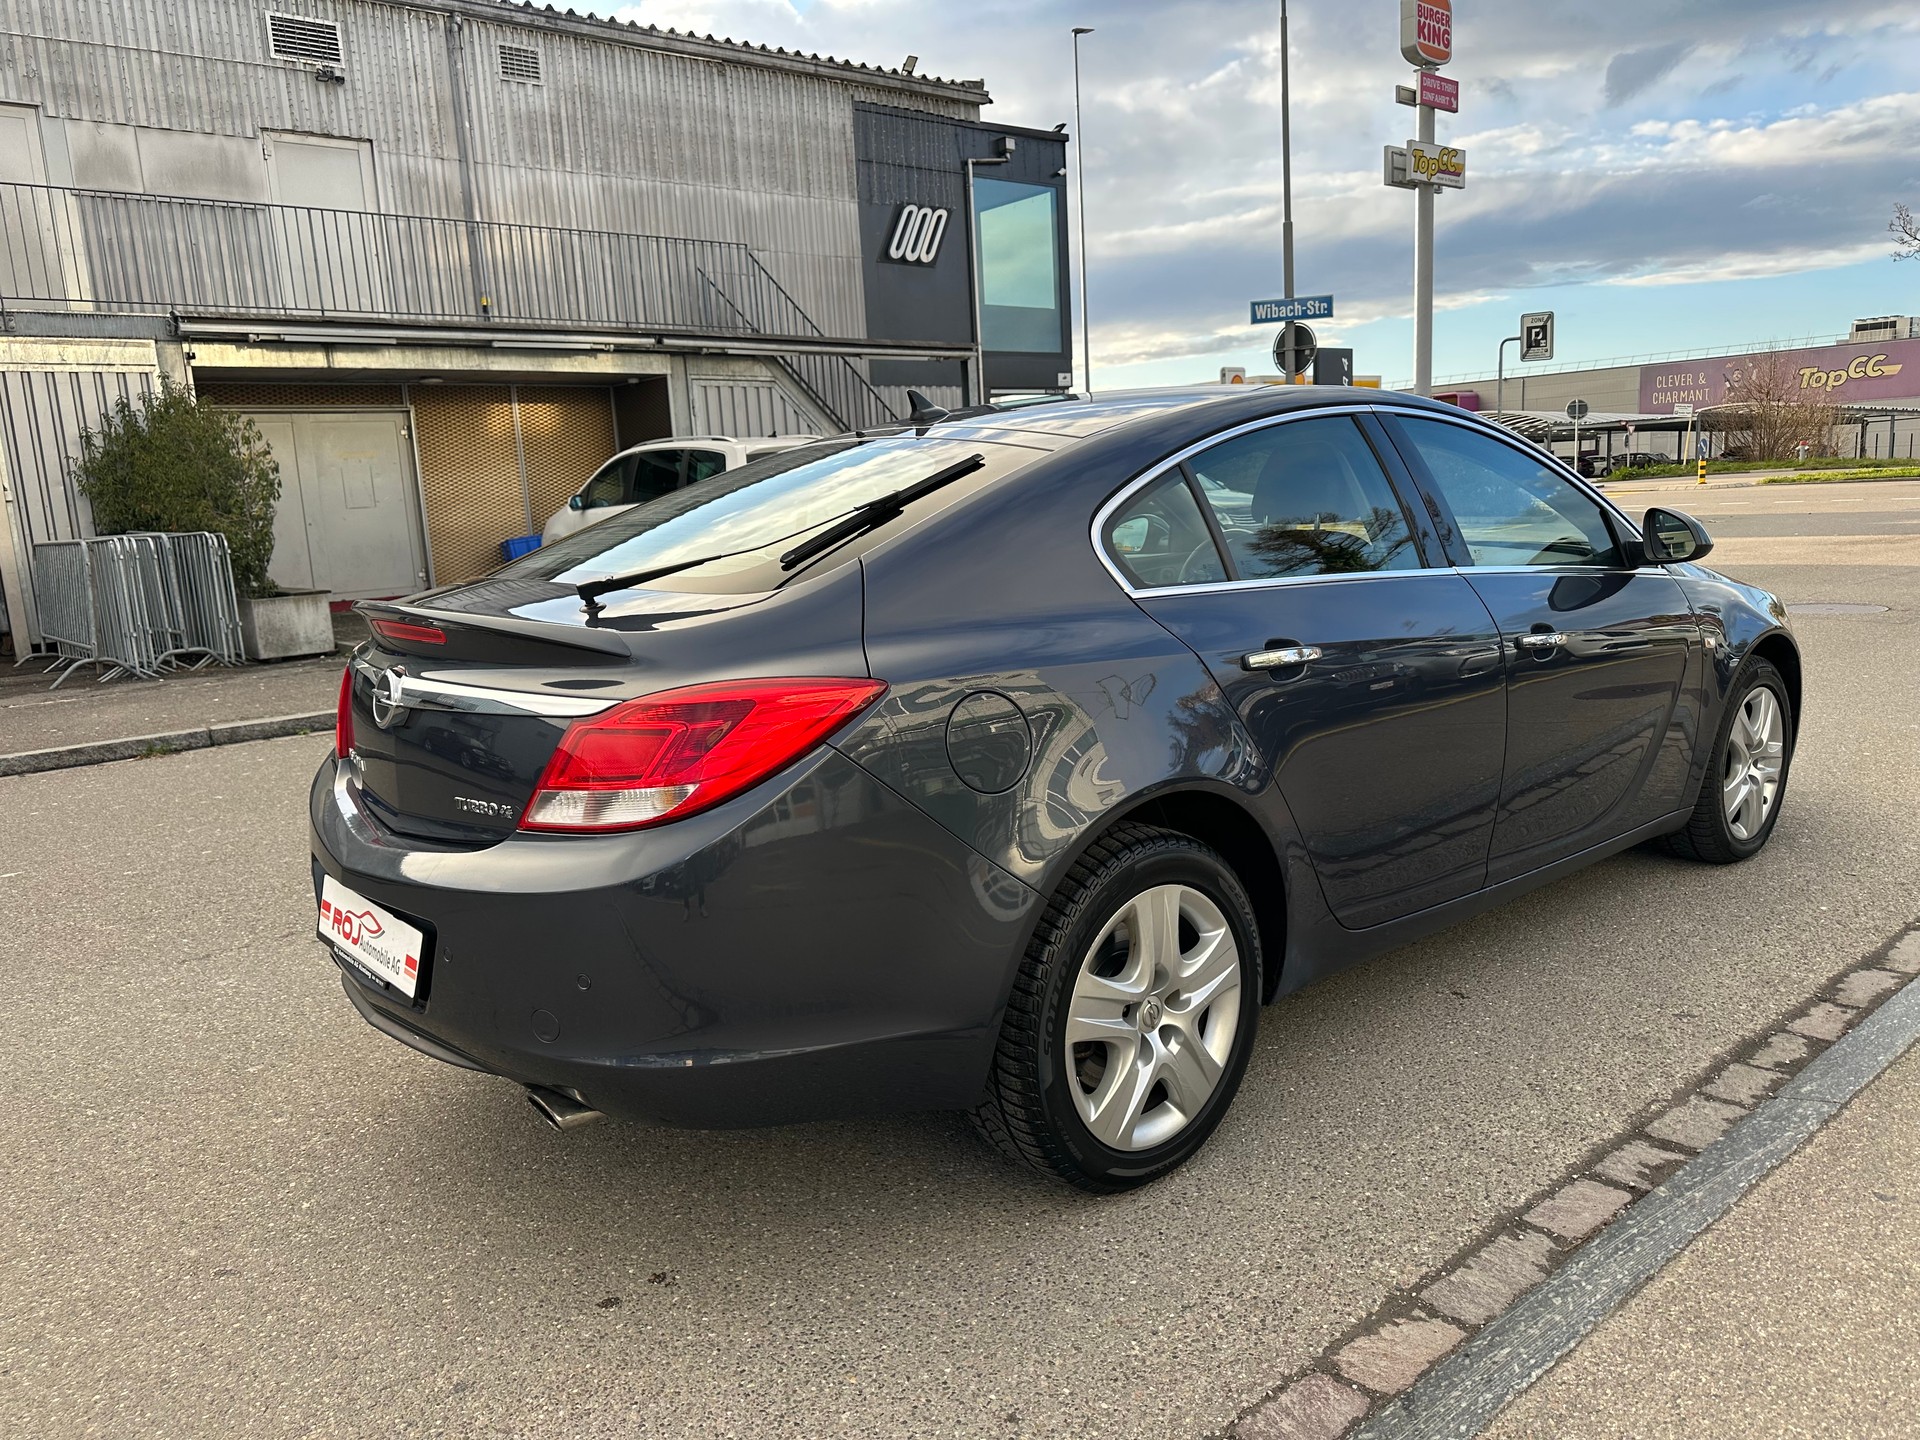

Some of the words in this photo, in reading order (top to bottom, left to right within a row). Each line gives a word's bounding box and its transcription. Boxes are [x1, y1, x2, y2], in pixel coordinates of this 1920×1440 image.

[1417, 3, 1450, 28] BURGER
[1417, 19, 1450, 49] KING
[1423, 77, 1440, 90] DRIVE
[1441, 81, 1457, 94] THRU
[1422, 91, 1450, 105] EINFAHRT
[1254, 300, 1328, 319] Wibach-Str.
[1656, 373, 1693, 388] CLEVER
[1698, 372, 1706, 384] &
[1652, 388, 1710, 405] CHARMANT
[454, 796, 498, 817] TURBO
[332, 907, 362, 946] ROJ
[359, 934, 391, 969] Automobile
[391, 956, 401, 976] AG
